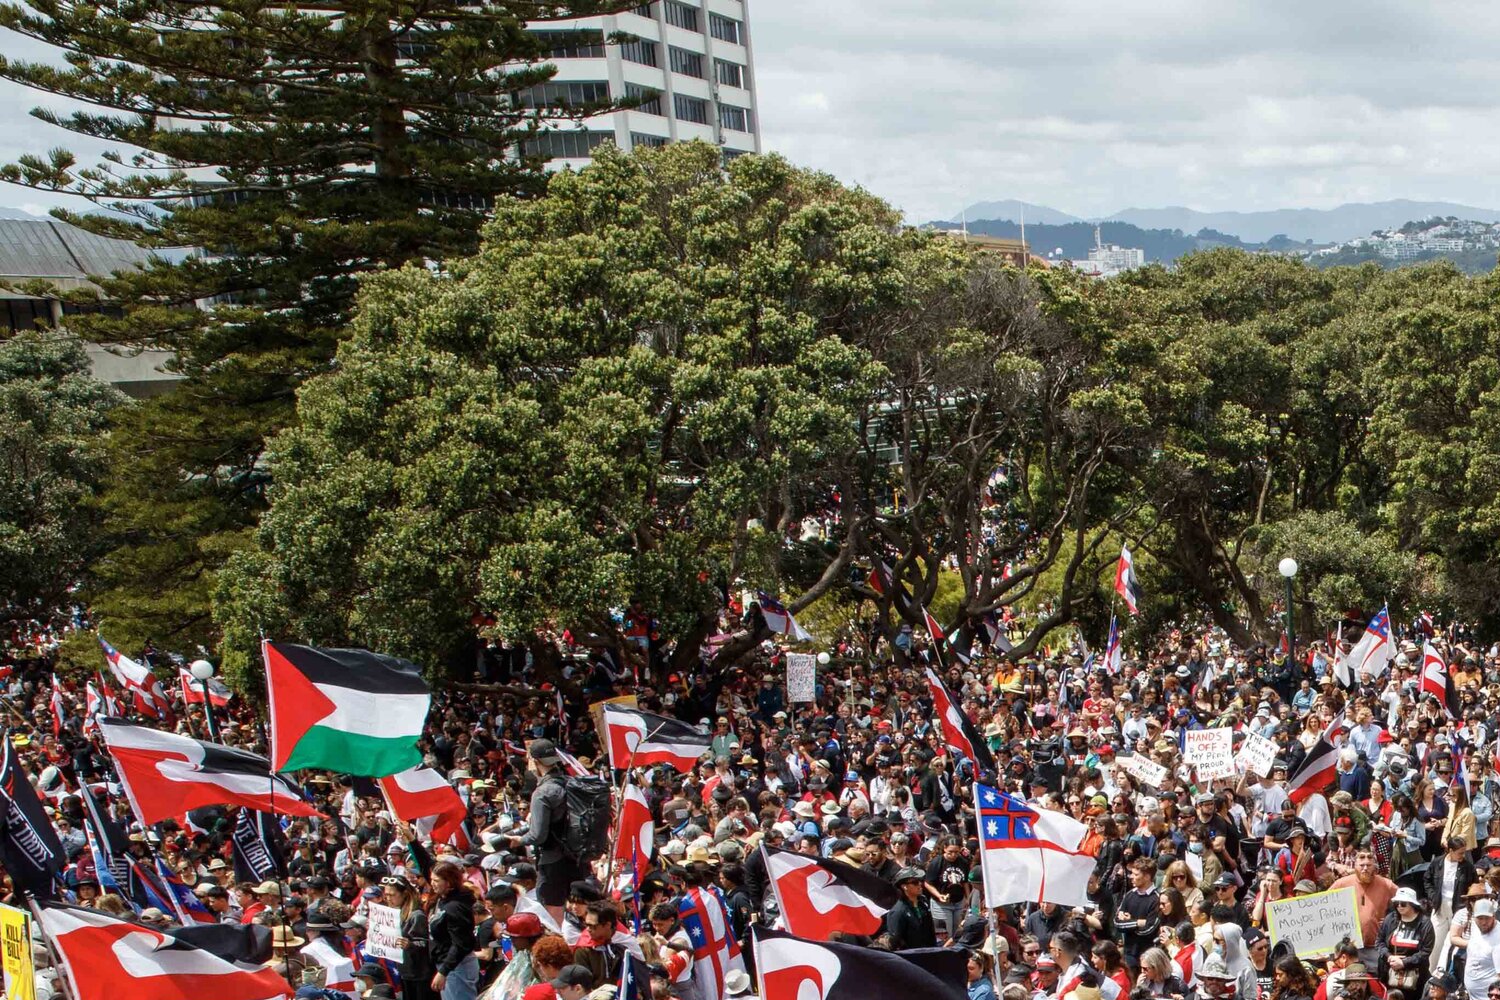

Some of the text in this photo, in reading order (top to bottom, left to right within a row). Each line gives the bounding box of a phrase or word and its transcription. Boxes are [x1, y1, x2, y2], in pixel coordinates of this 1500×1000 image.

[1187, 734, 1222, 742] HANDS
[1198, 742, 1218, 751] OFF
[1191, 753, 1204, 761] MY
[1200, 761, 1225, 770] PROUD
[1273, 904, 1293, 916] Hey
[1279, 907, 1347, 929] Maybe Politics
[5, 923, 20, 943] KILL
[1306, 924, 1326, 941] your
[7, 941, 21, 960] BILL
